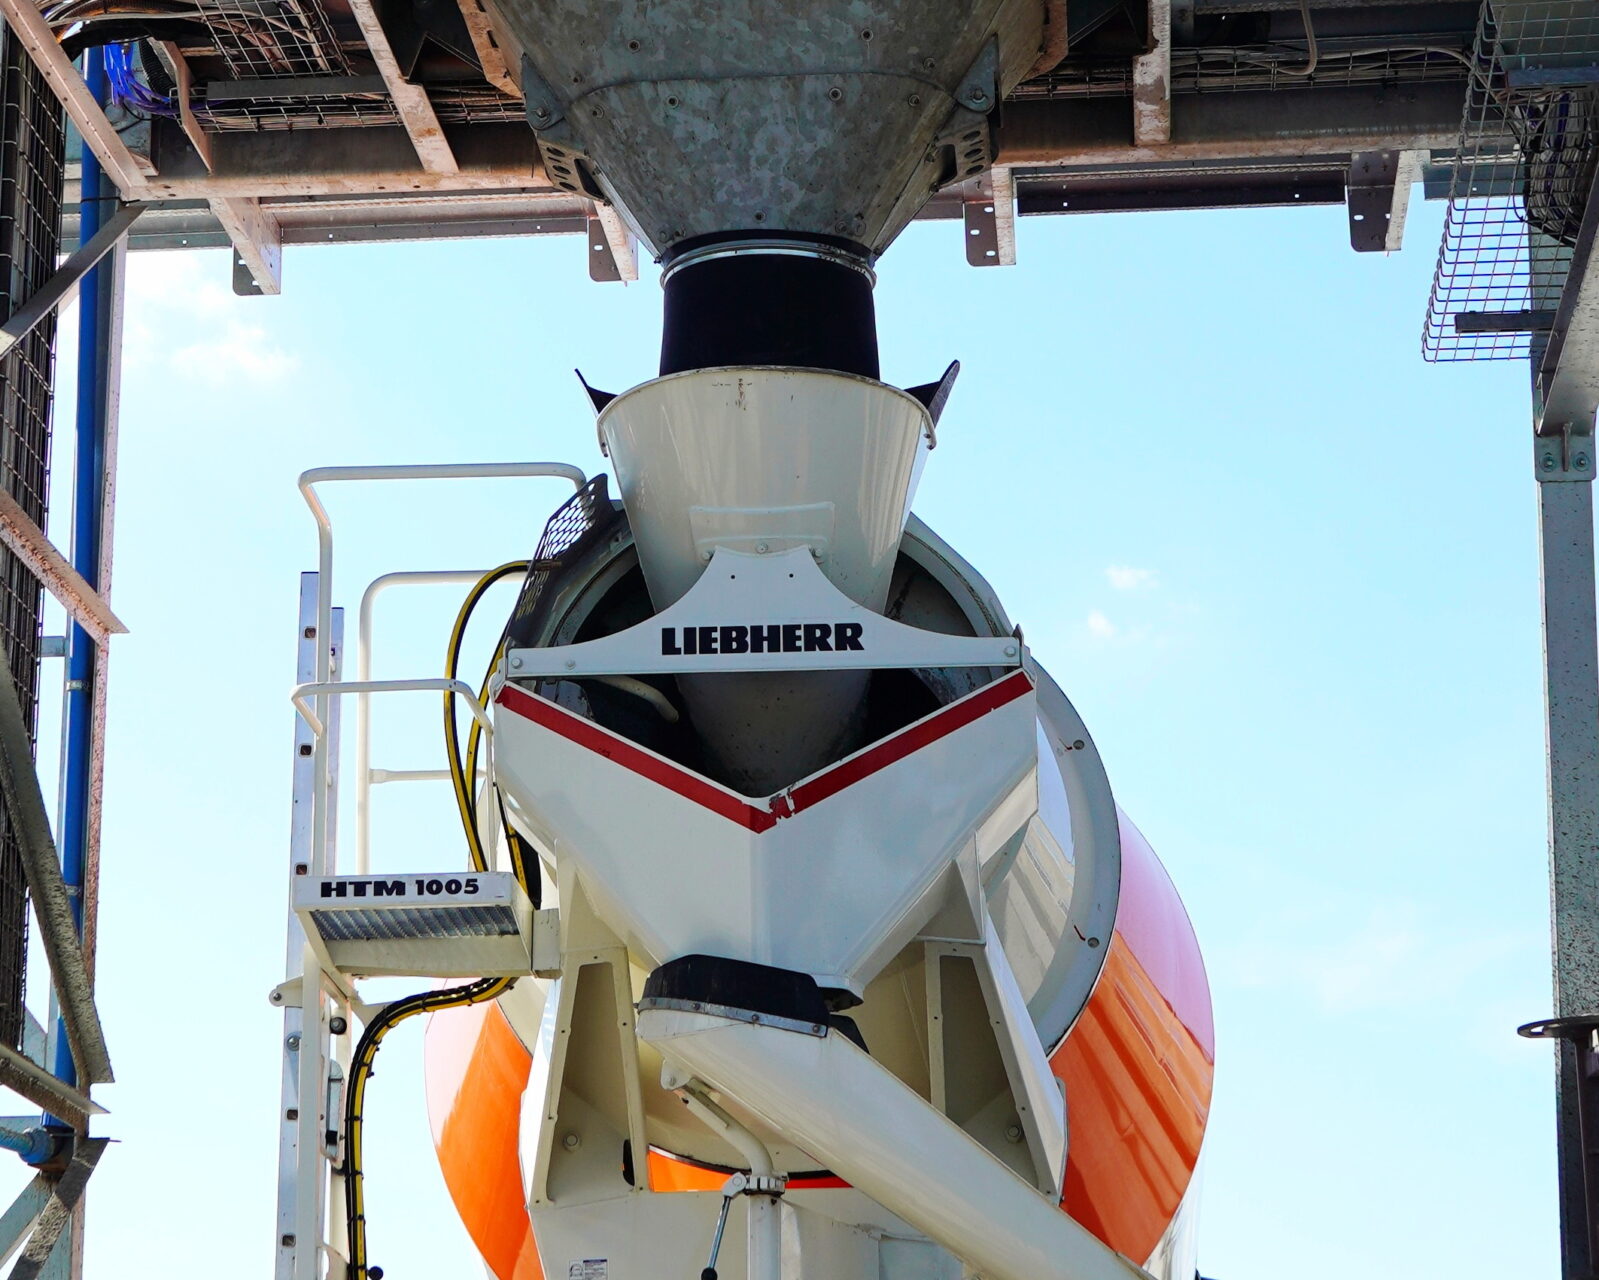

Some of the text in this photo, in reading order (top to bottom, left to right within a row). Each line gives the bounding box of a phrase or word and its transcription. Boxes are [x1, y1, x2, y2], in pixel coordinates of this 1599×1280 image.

[662, 623, 865, 655] LIEBHERR
[321, 878, 480, 898] HTM 1005
